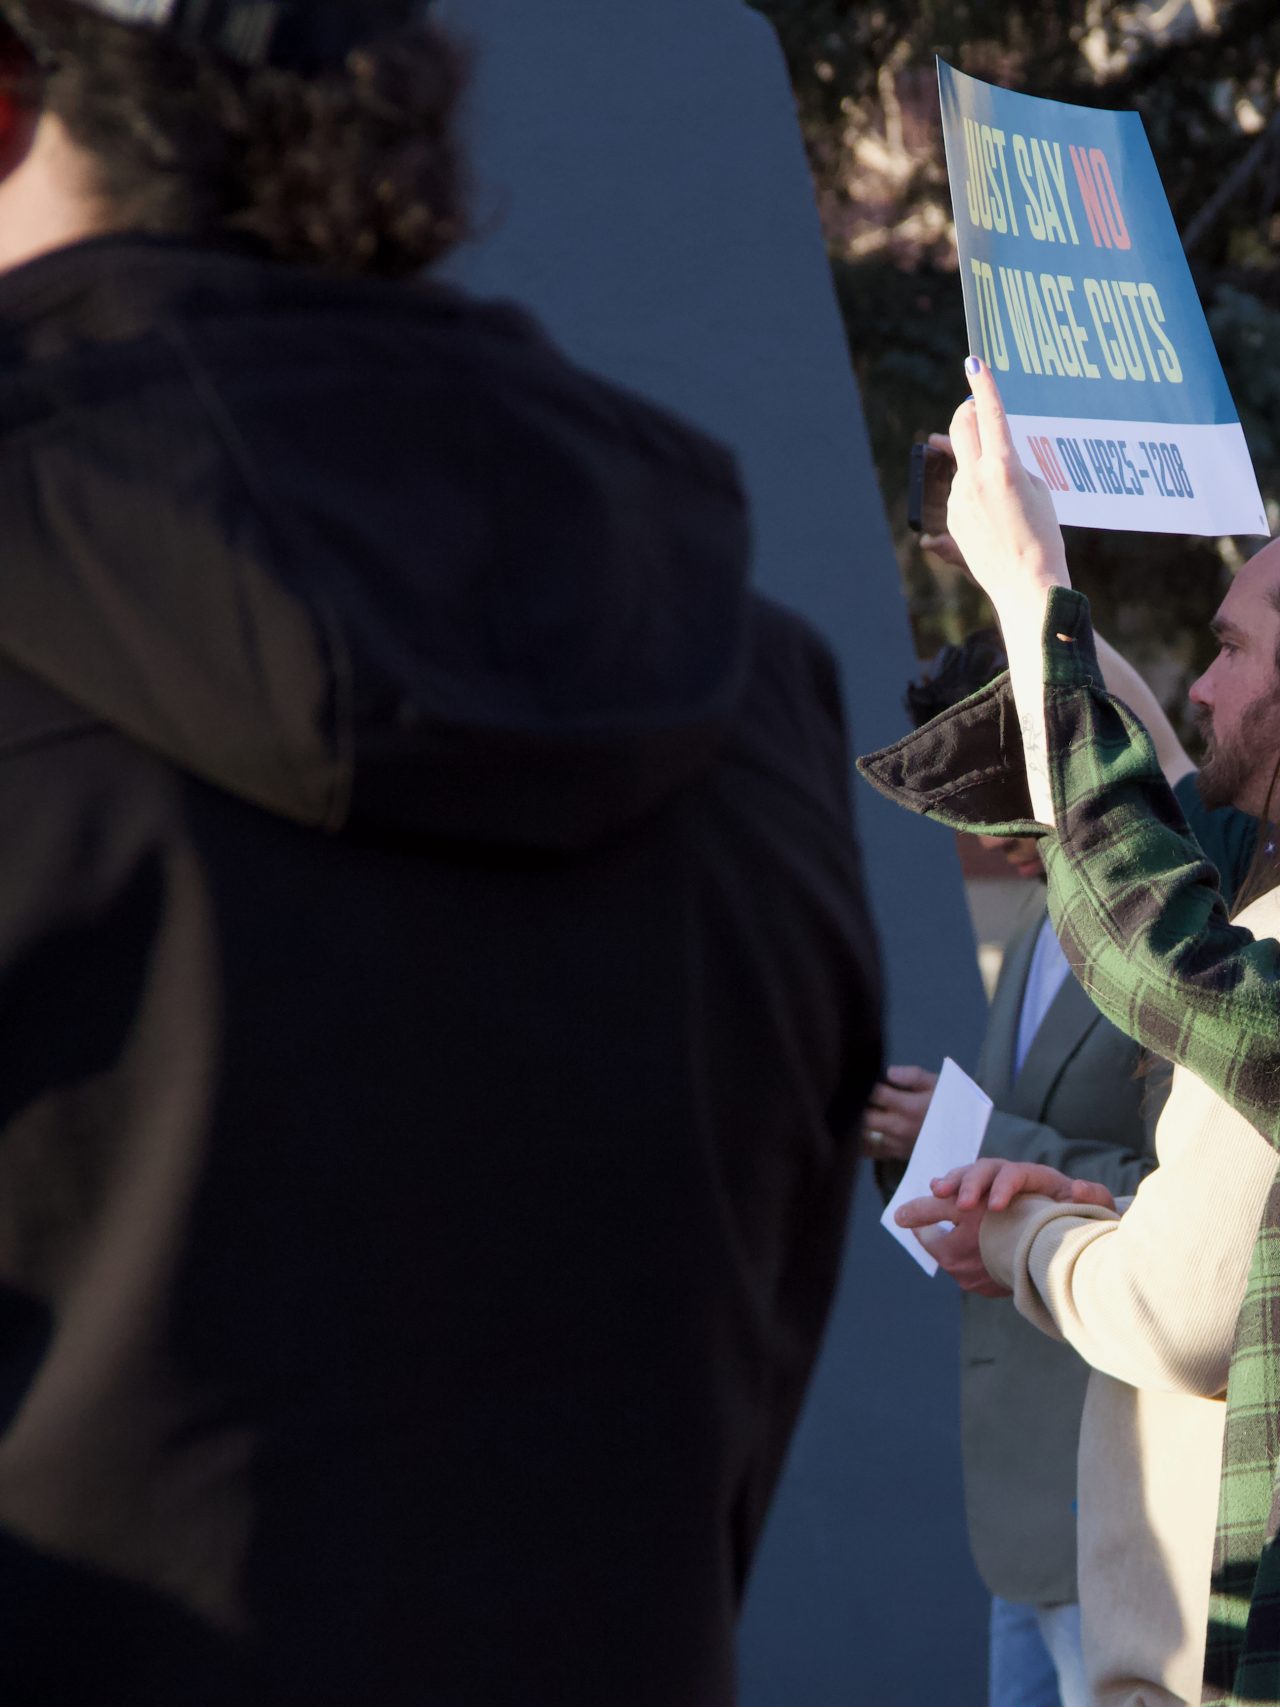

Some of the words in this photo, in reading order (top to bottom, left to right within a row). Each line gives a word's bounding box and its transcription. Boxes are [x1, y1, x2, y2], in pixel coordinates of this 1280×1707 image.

[963, 117, 1019, 236] JUST
[1012, 134, 1080, 245] SAY
[1069, 144, 1131, 250] NO
[971, 258, 1010, 371] TO
[998, 266, 1101, 379] WAGE
[1083, 278, 1183, 384] CUTS
[1026, 435, 1070, 492] NO
[1056, 437, 1097, 494] ON
[1083, 438, 1195, 499] HB25-1208
